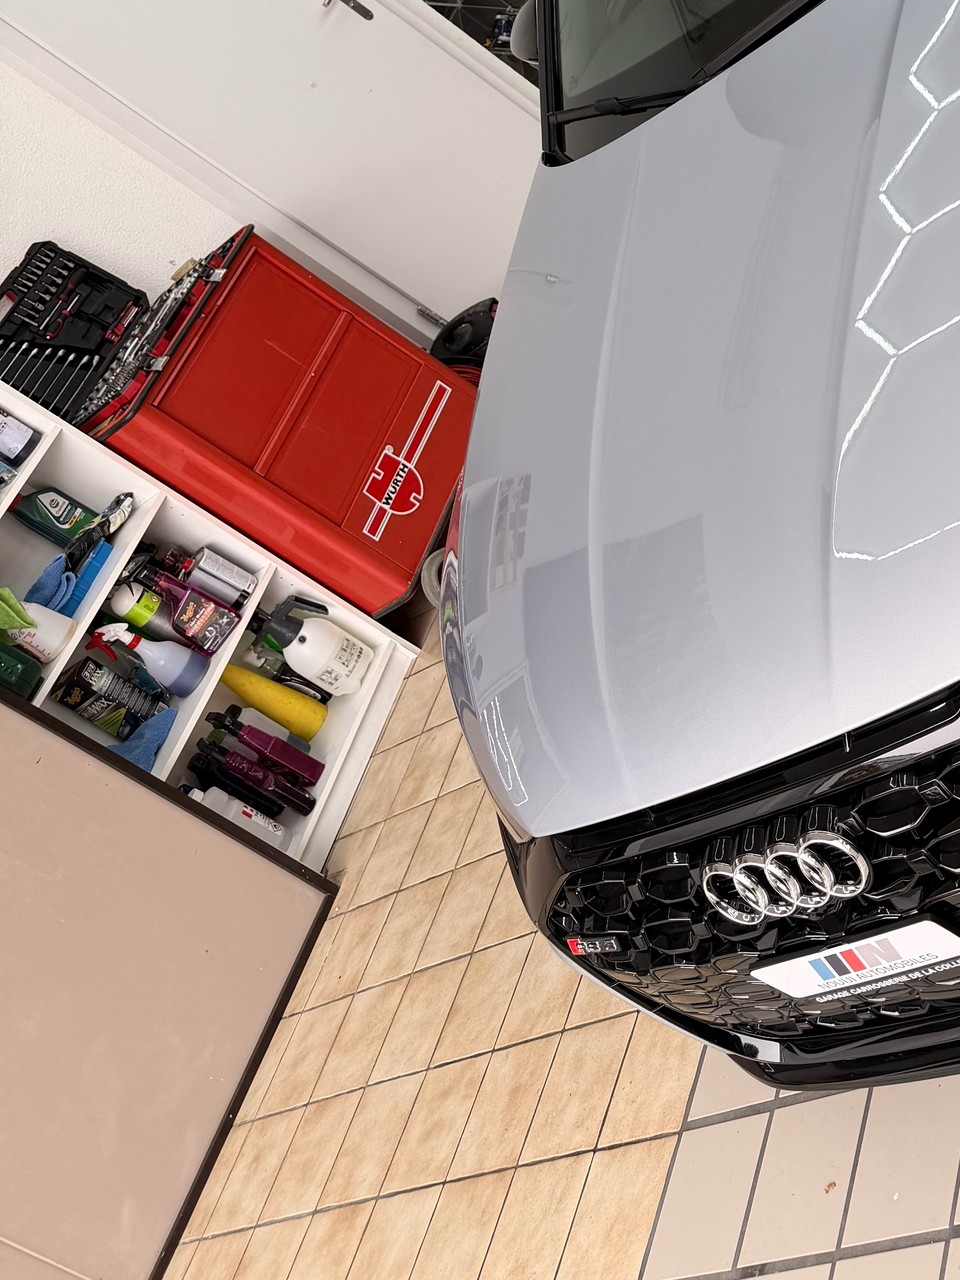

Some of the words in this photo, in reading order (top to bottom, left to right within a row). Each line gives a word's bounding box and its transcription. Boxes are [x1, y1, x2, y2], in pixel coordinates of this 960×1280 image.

[856, 952, 939, 980] AUTOMOBILES
[815, 990, 852, 1003] GARAGE
[850, 974, 910, 995] CARROSSERIE
[908, 971, 924, 980] DE
[921, 967, 937, 976] LA
